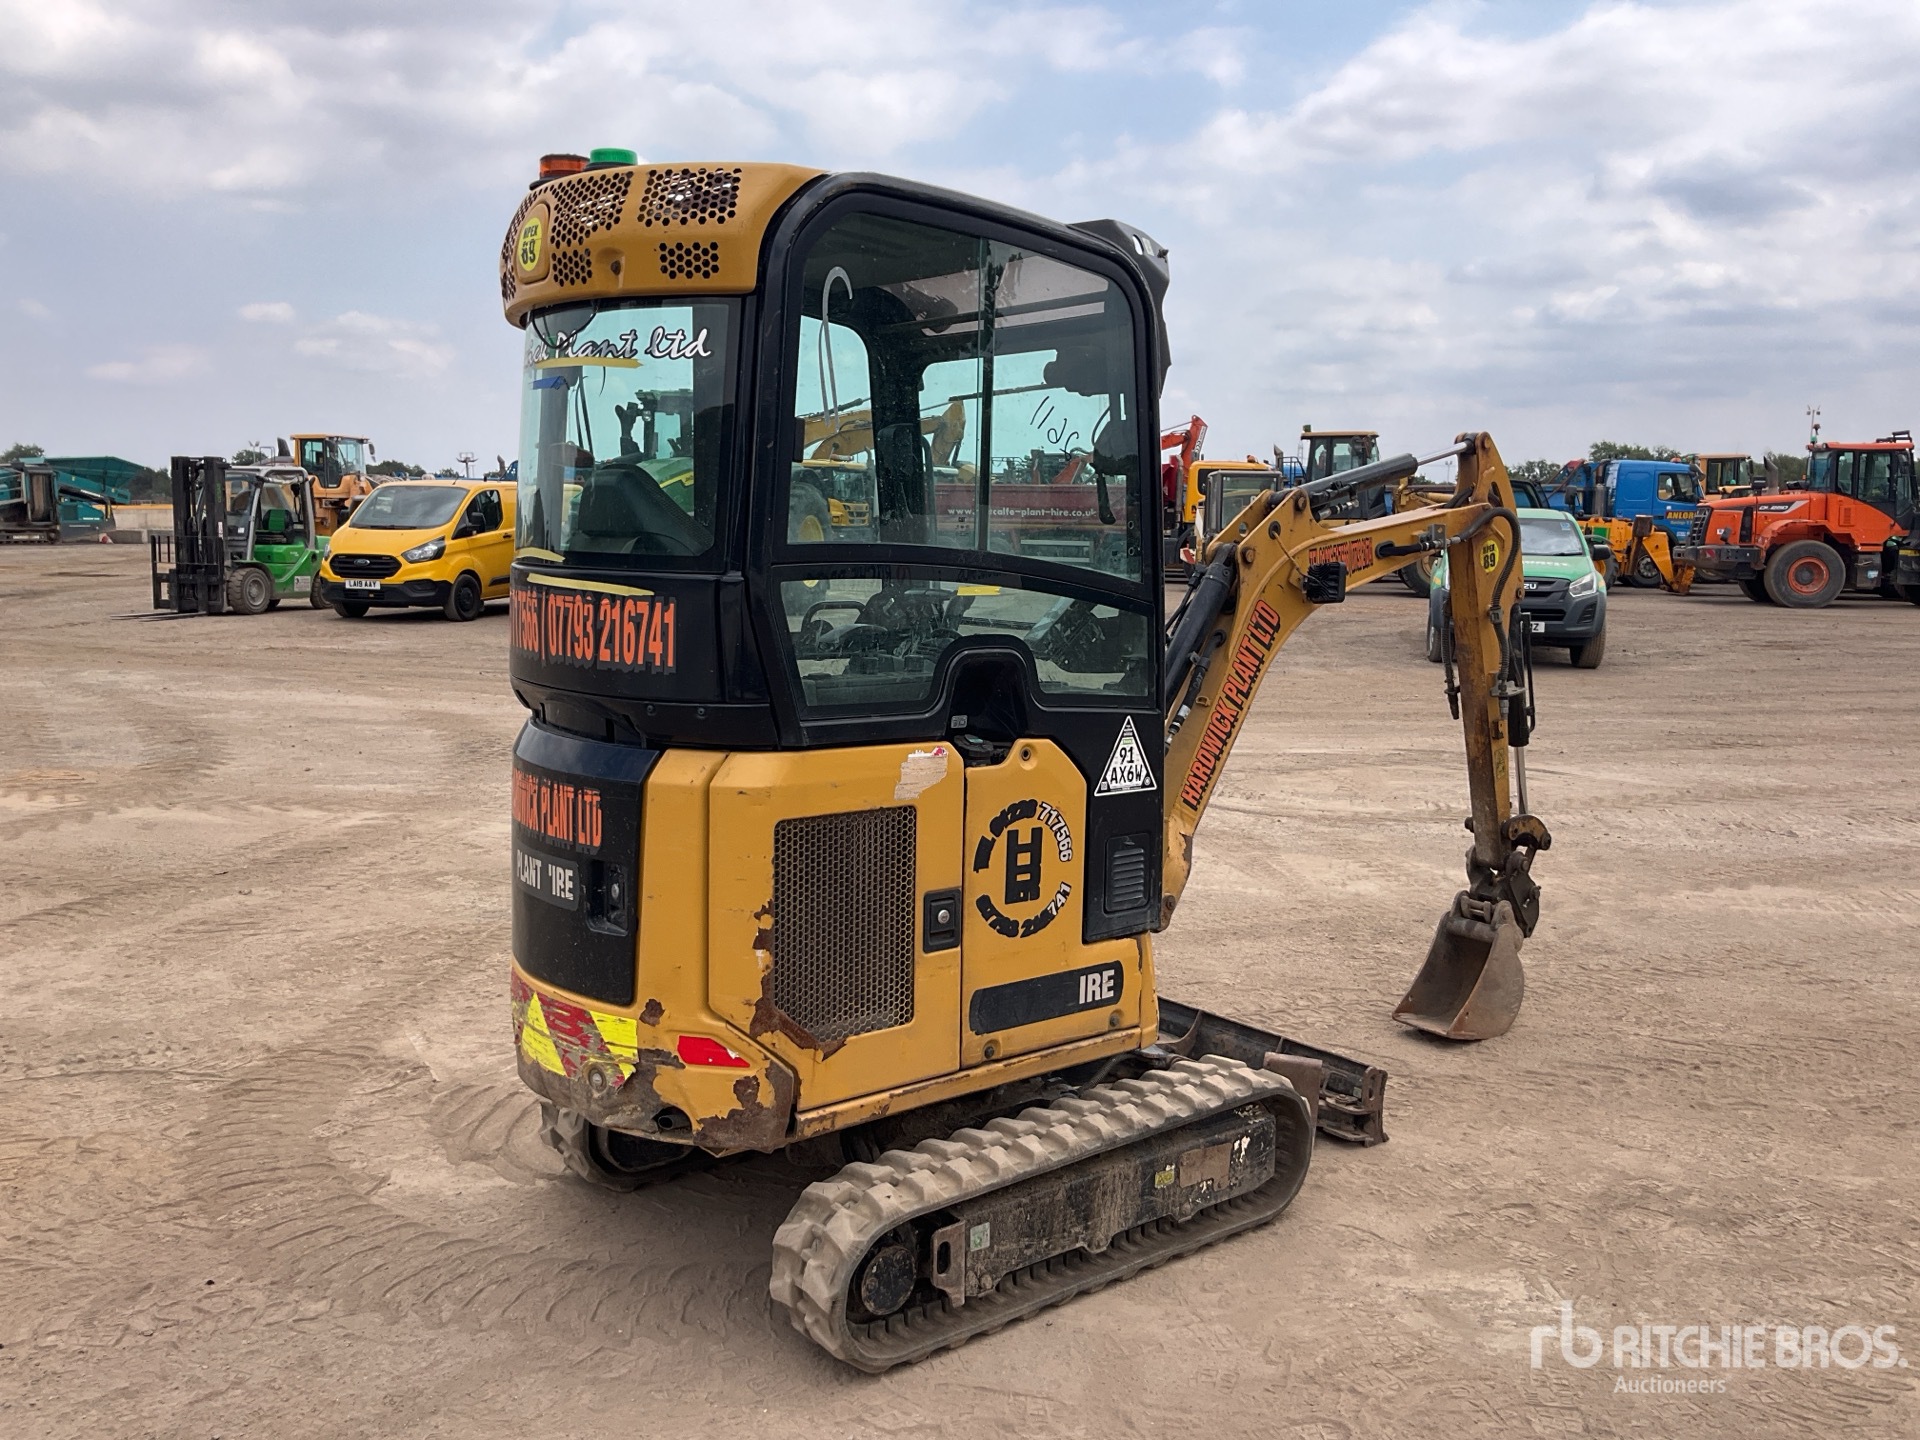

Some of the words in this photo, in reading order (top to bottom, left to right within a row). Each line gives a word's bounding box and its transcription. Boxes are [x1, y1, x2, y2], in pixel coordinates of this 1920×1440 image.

[1484, 553, 1496, 569] 89
[548, 593, 594, 661] 07793
[599, 597, 676, 668] 216741
[1181, 697, 1239, 809] HARDWICK
[1222, 635, 1264, 707] PLANT
[1247, 599, 1281, 648] LTD
[1120, 747, 1134, 764] 91
[1110, 765, 1143, 784] AX6W
[1038, 802, 1073, 862] 717566
[548, 864, 574, 900] IRE
